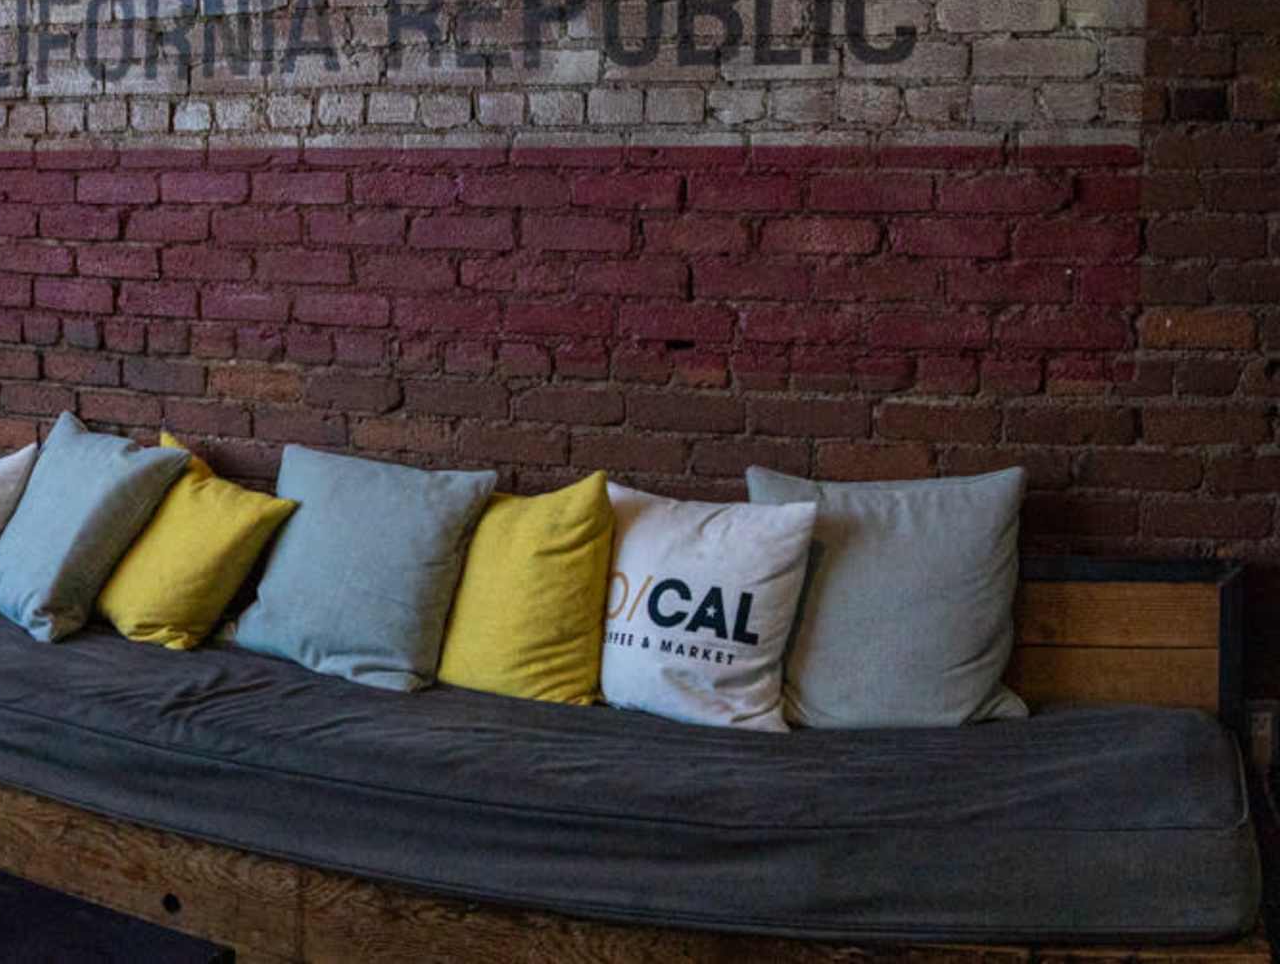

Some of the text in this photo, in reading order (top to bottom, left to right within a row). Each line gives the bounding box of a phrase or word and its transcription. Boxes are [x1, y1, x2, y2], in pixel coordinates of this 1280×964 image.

[608, 571, 759, 645] O/CAL
[641, 635, 650, 649] &
[660, 639, 736, 666] MARKET
